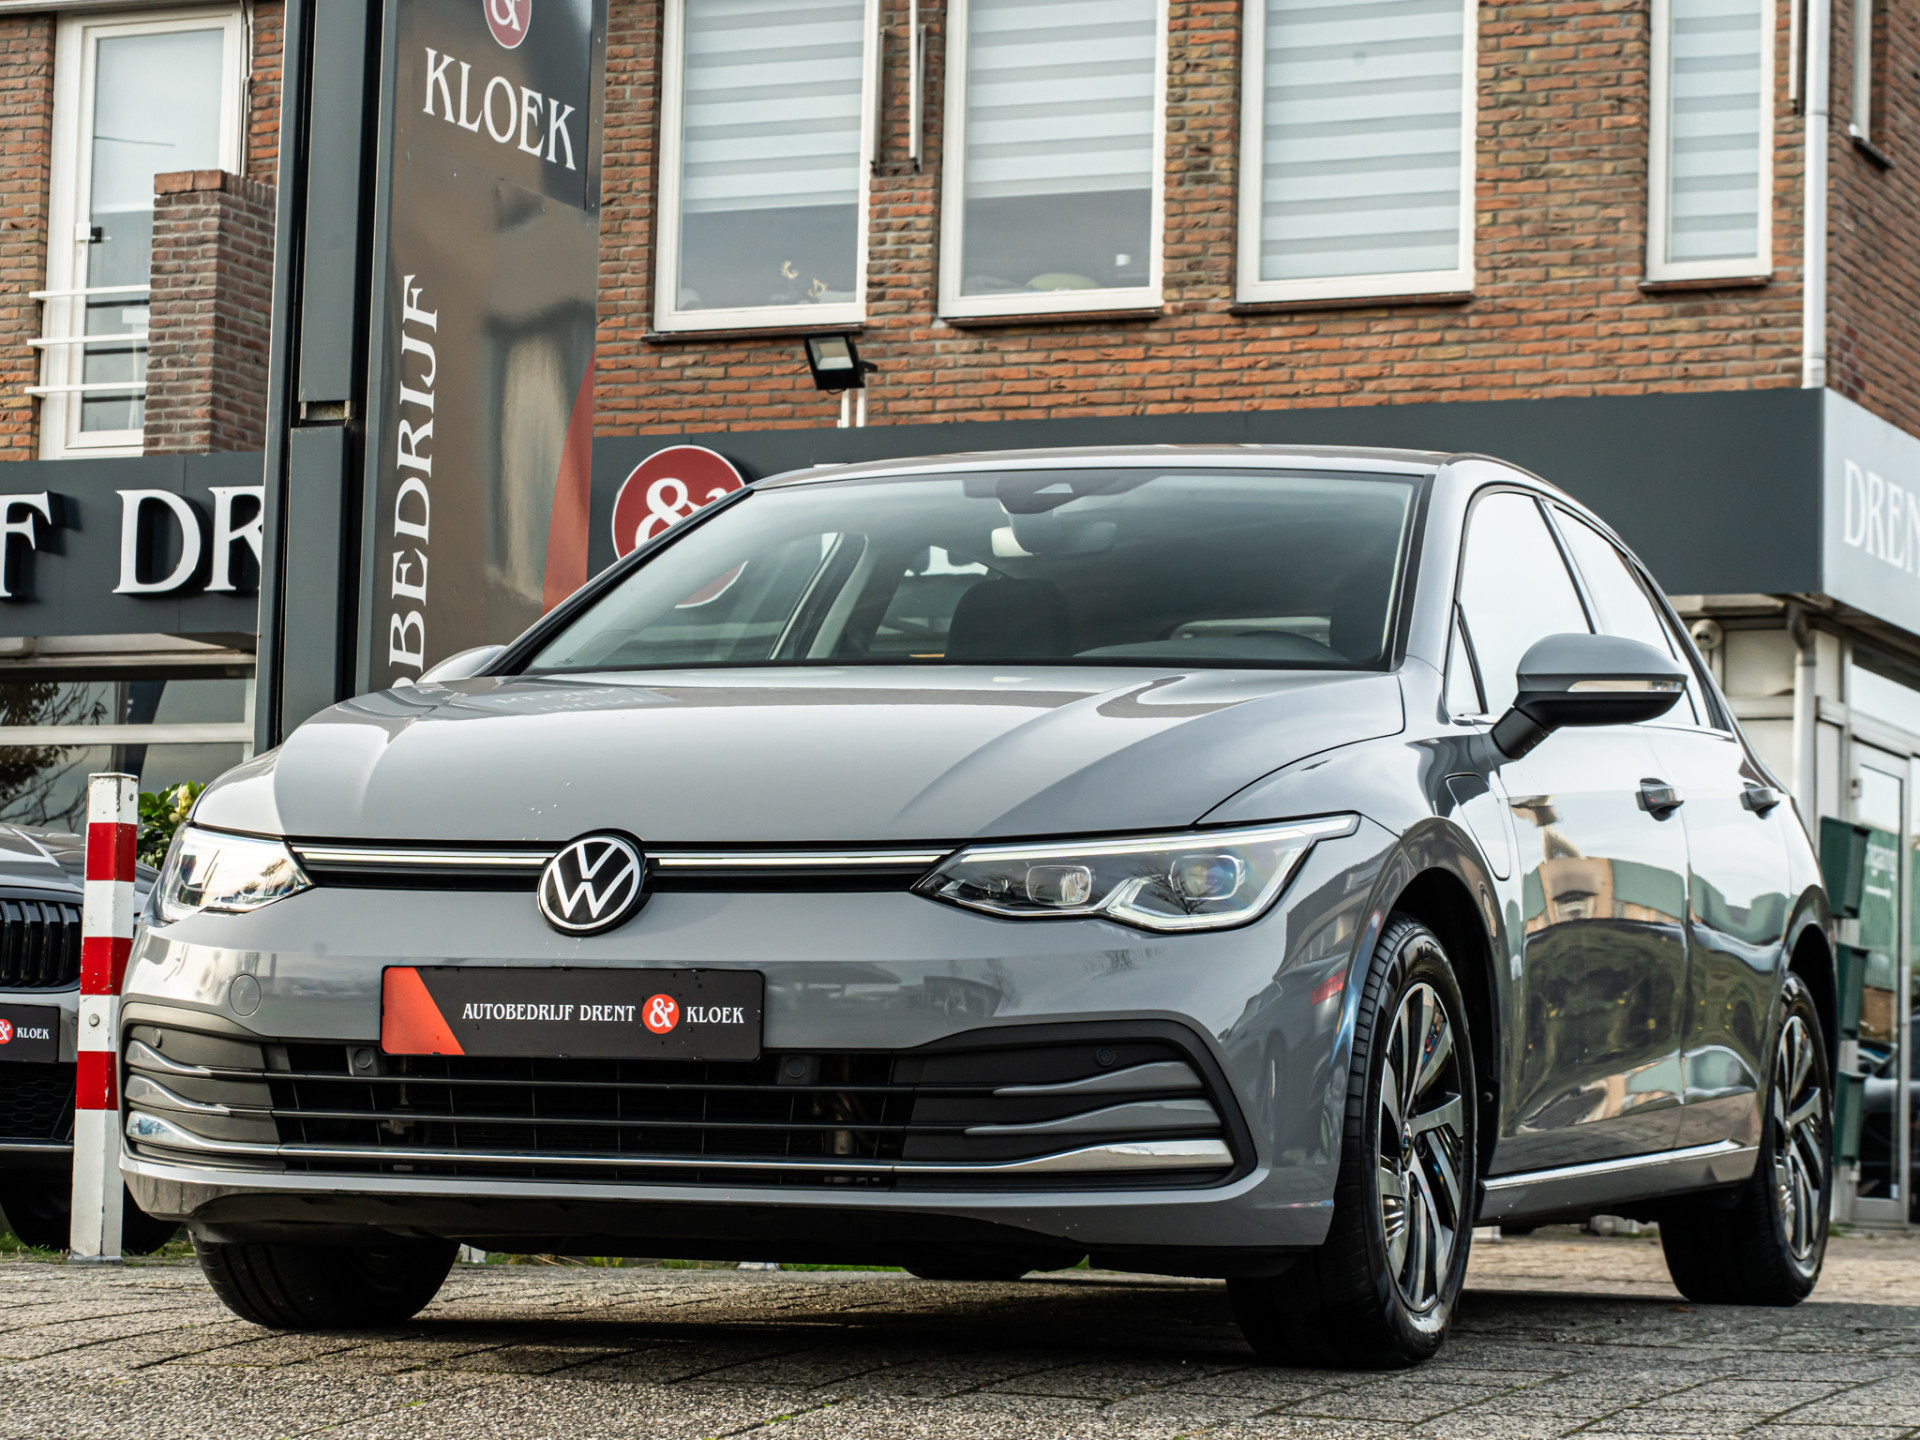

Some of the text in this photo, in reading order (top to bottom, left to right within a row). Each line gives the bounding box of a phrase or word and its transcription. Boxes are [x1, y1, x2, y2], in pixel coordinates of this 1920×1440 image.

[423, 47, 576, 170] KLOEK
[389, 274, 438, 689] BEDRIJF
[17, 1027, 49, 1040] KLOEK
[462, 997, 745, 1028] AUTOBEDRIJF DRENT & KLOEK
